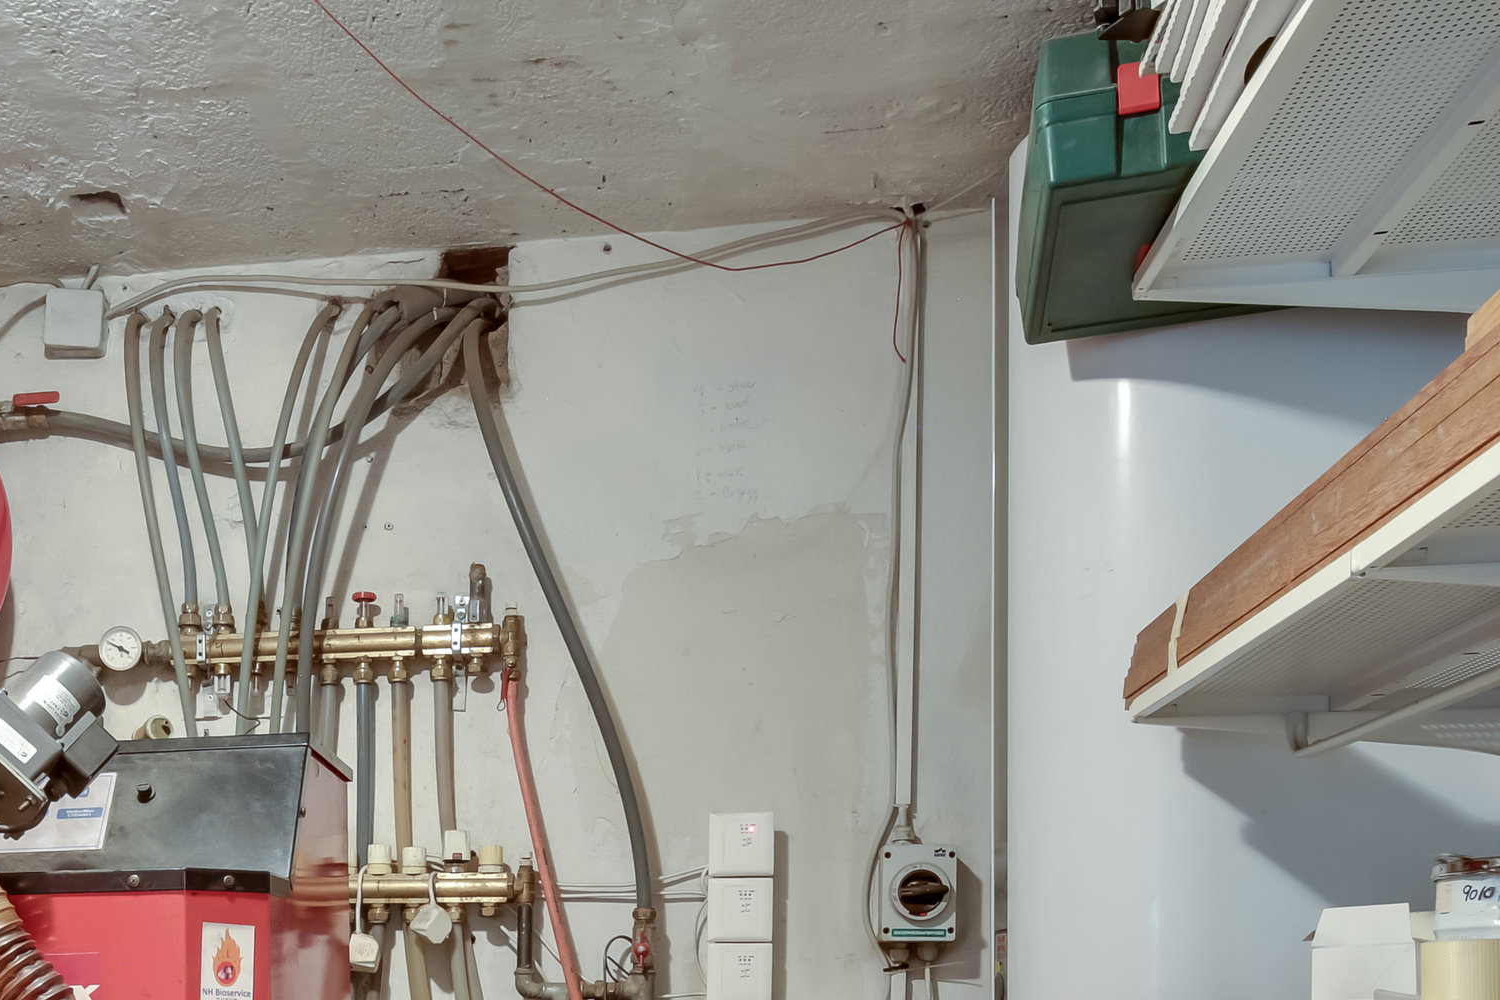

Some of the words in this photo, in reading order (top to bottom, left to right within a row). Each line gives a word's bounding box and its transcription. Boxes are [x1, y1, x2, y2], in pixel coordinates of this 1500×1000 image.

[1462, 884, 1496, 902] 9010
[202, 988, 214, 996] NH
[215, 988, 252, 998] Bioservice
